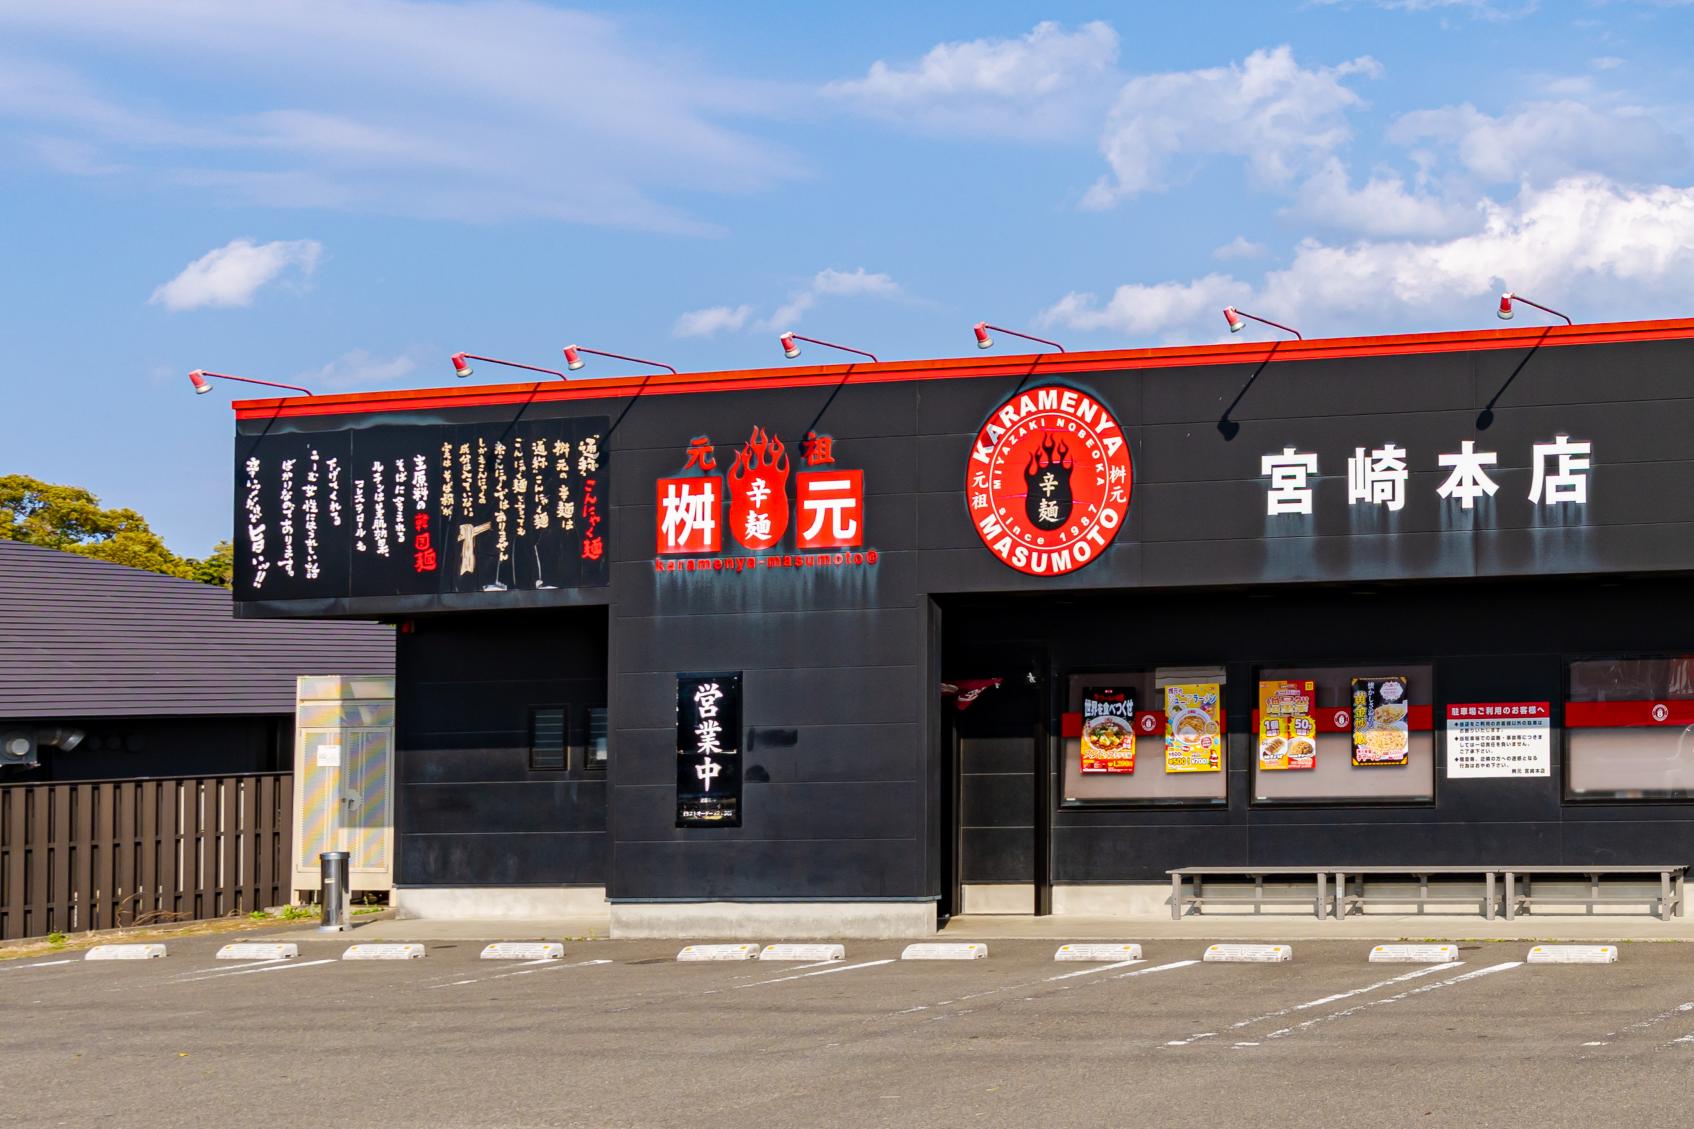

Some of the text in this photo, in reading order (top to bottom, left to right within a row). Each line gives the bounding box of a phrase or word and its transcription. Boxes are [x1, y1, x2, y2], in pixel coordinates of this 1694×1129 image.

[683, 432, 835, 471] 元 祖
[972, 390, 1123, 464] KARAMENYA
[993, 418, 1104, 489] MIYAZAKI NOBEOKA
[972, 472, 988, 510] 元祖
[1038, 472, 1059, 522] 辛麺
[1261, 434, 1591, 515] 宮崎本店
[745, 478, 772, 541] 辛麺
[999, 504, 1097, 544] since 1987
[979, 508, 1118, 573] MASUMOTO
[1084, 699, 1134, 717] 世界を食べつくせ
[1451, 706, 1545, 716] 駐車場ご利用のお客様へ
[694, 683, 723, 792] 営業中
